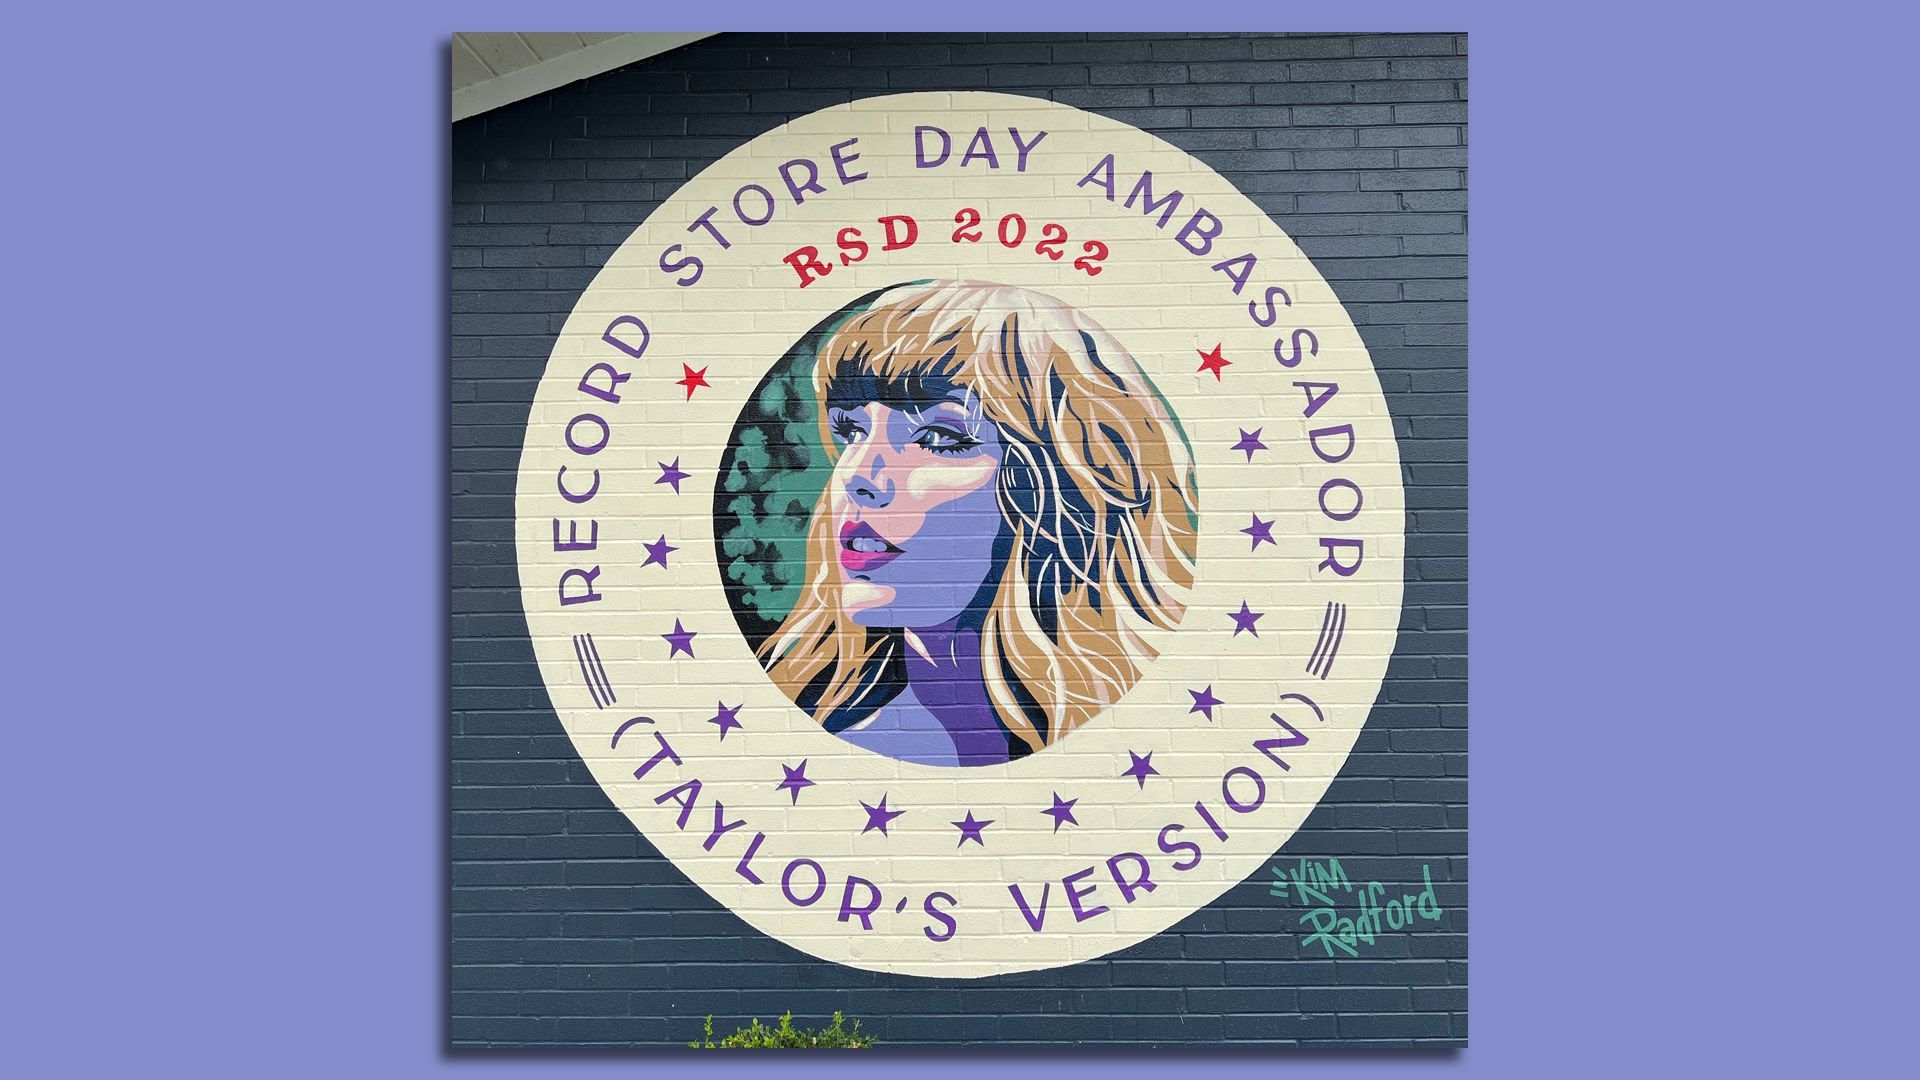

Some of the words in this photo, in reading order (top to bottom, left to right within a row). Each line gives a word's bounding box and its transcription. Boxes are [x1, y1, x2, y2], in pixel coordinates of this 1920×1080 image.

[783, 214, 919, 288] RSD
[952, 207, 1109, 277] 2022
[553, 314, 651, 606] RECORD
[659, 137, 868, 288] STORE
[915, 125, 1048, 172] DAY
[1077, 153, 1364, 578] AMBASSADOR
[611, 716, 957, 943] (TAYLOR'S
[1008, 693, 1324, 933] VERSION)
[1300, 864, 1443, 957] Radford
